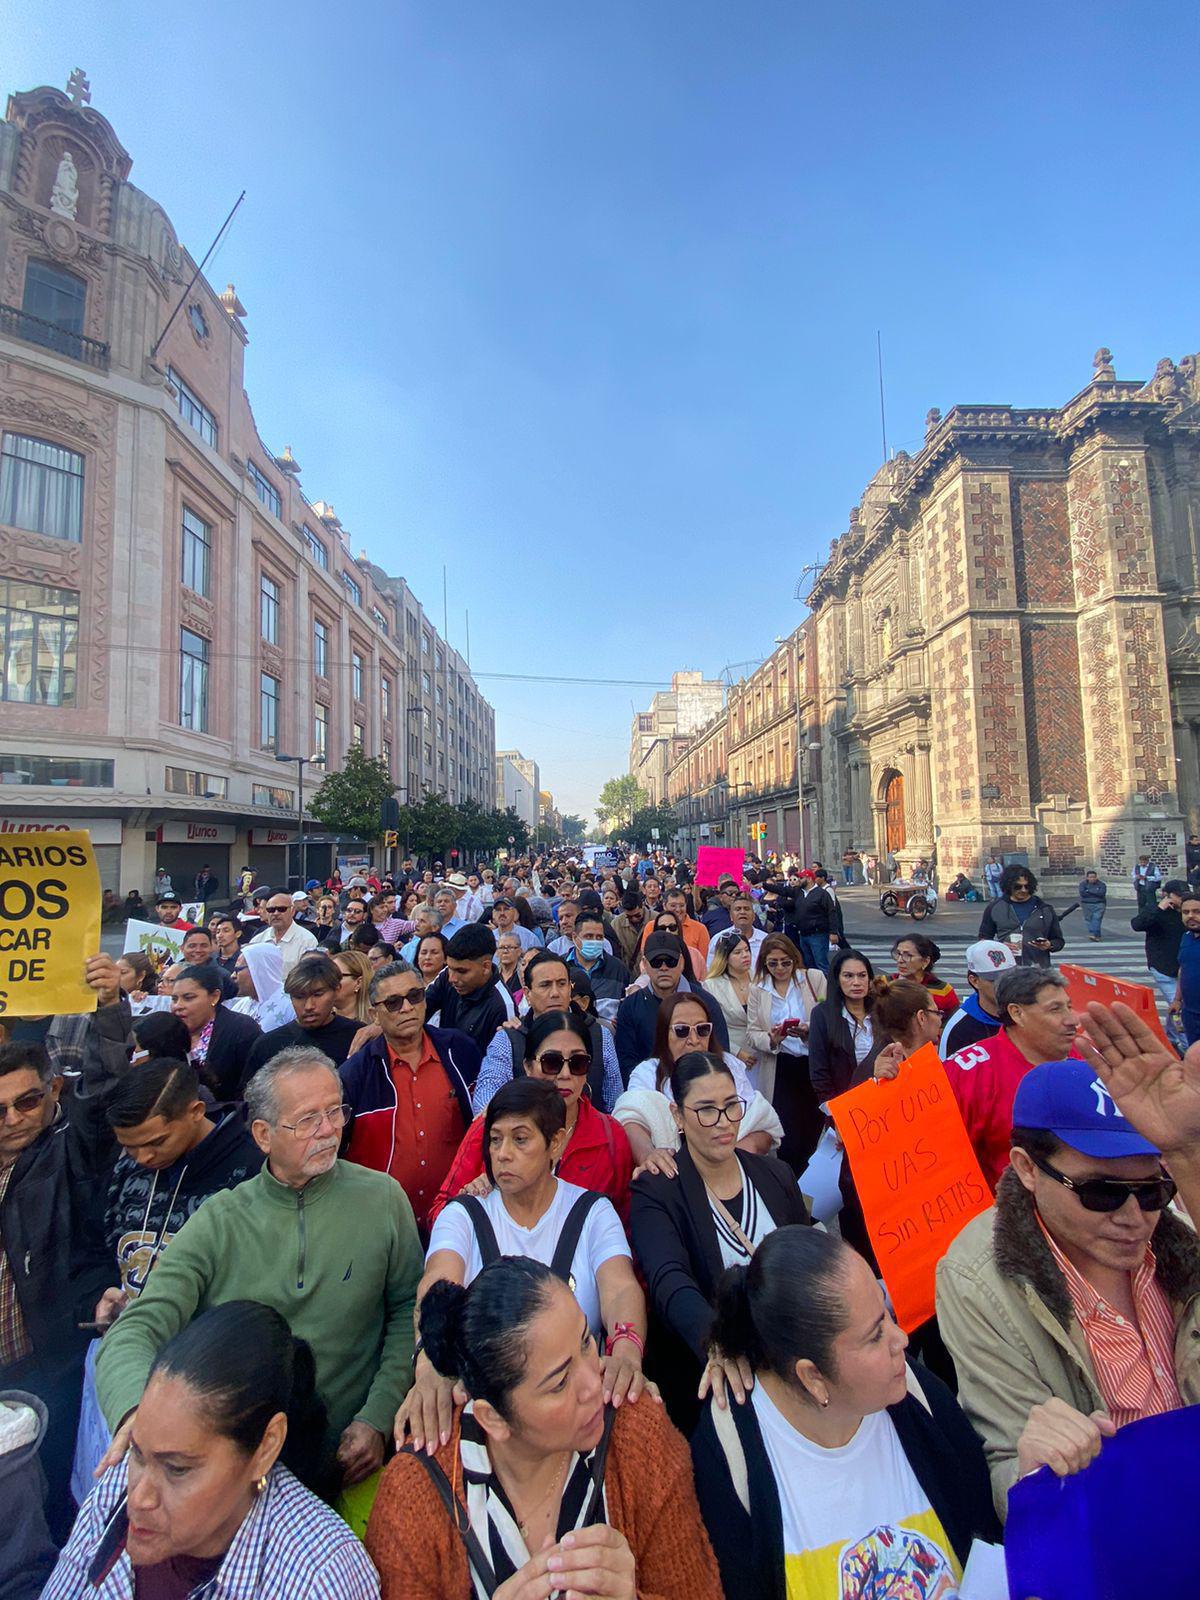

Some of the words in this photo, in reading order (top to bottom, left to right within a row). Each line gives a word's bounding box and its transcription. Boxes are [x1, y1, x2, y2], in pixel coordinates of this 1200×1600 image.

[187, 823, 218, 839] Junco
[0, 879, 70, 921] OS
[0, 928, 52, 951] CAR
[8, 958, 46, 982] DE
[849, 1107, 890, 1150] Por
[883, 1137, 938, 1192] UAS
[922, 1171, 984, 1233] RATAS
